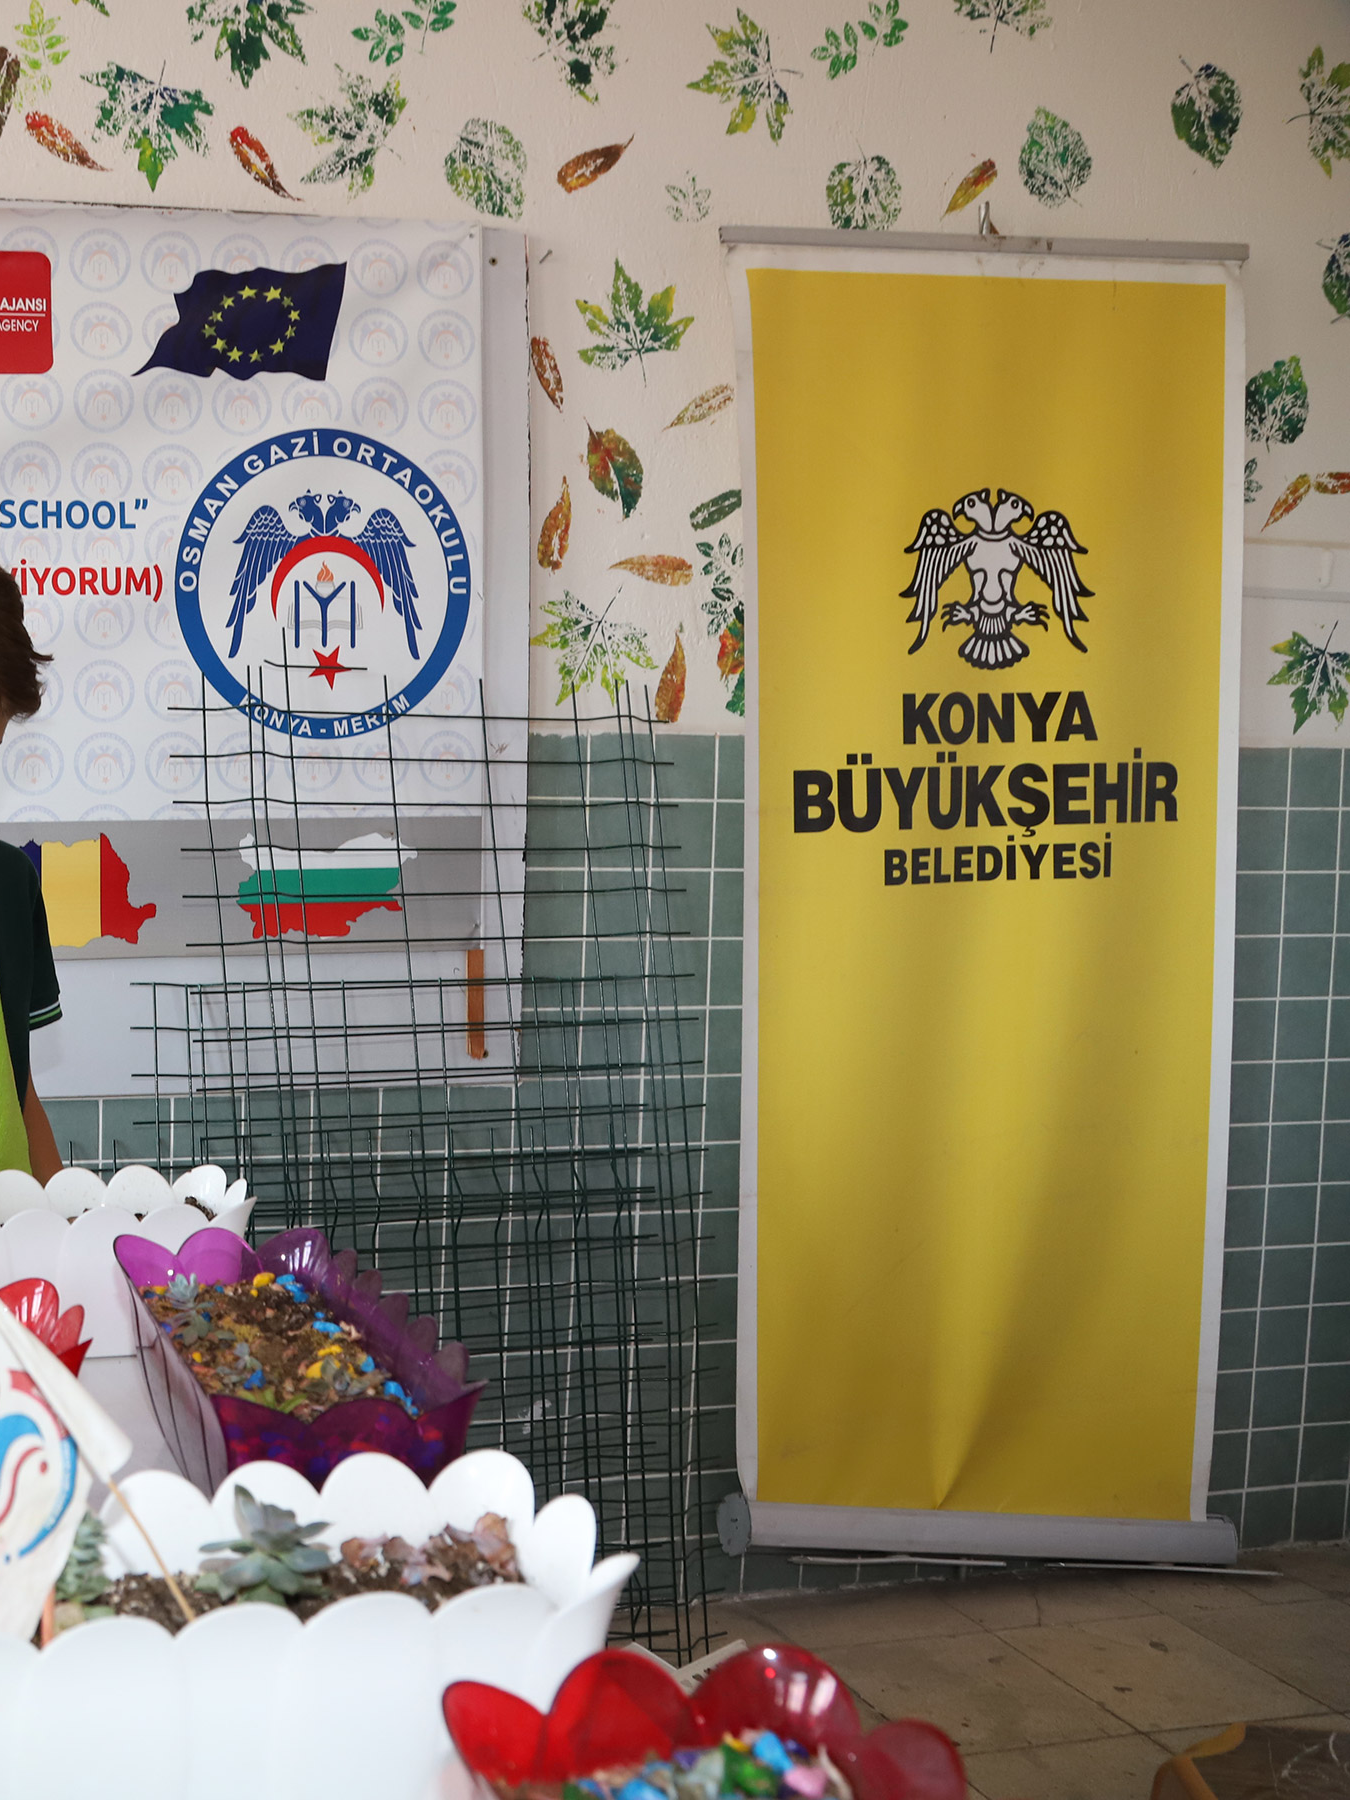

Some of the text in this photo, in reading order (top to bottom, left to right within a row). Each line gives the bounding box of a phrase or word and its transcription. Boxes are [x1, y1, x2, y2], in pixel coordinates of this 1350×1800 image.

[0, 297, 47, 312] AJANSI
[179, 431, 467, 595] OSMAN GAZİ ORTAOKULU
[10, 558, 163, 602] İYORUM)
[333, 693, 410, 737] MERAM
[902, 691, 1099, 745] KONYA
[793, 747, 1179, 838] BÜYÜKŞEHİR
[884, 832, 1112, 886] BELEDİYESİ
